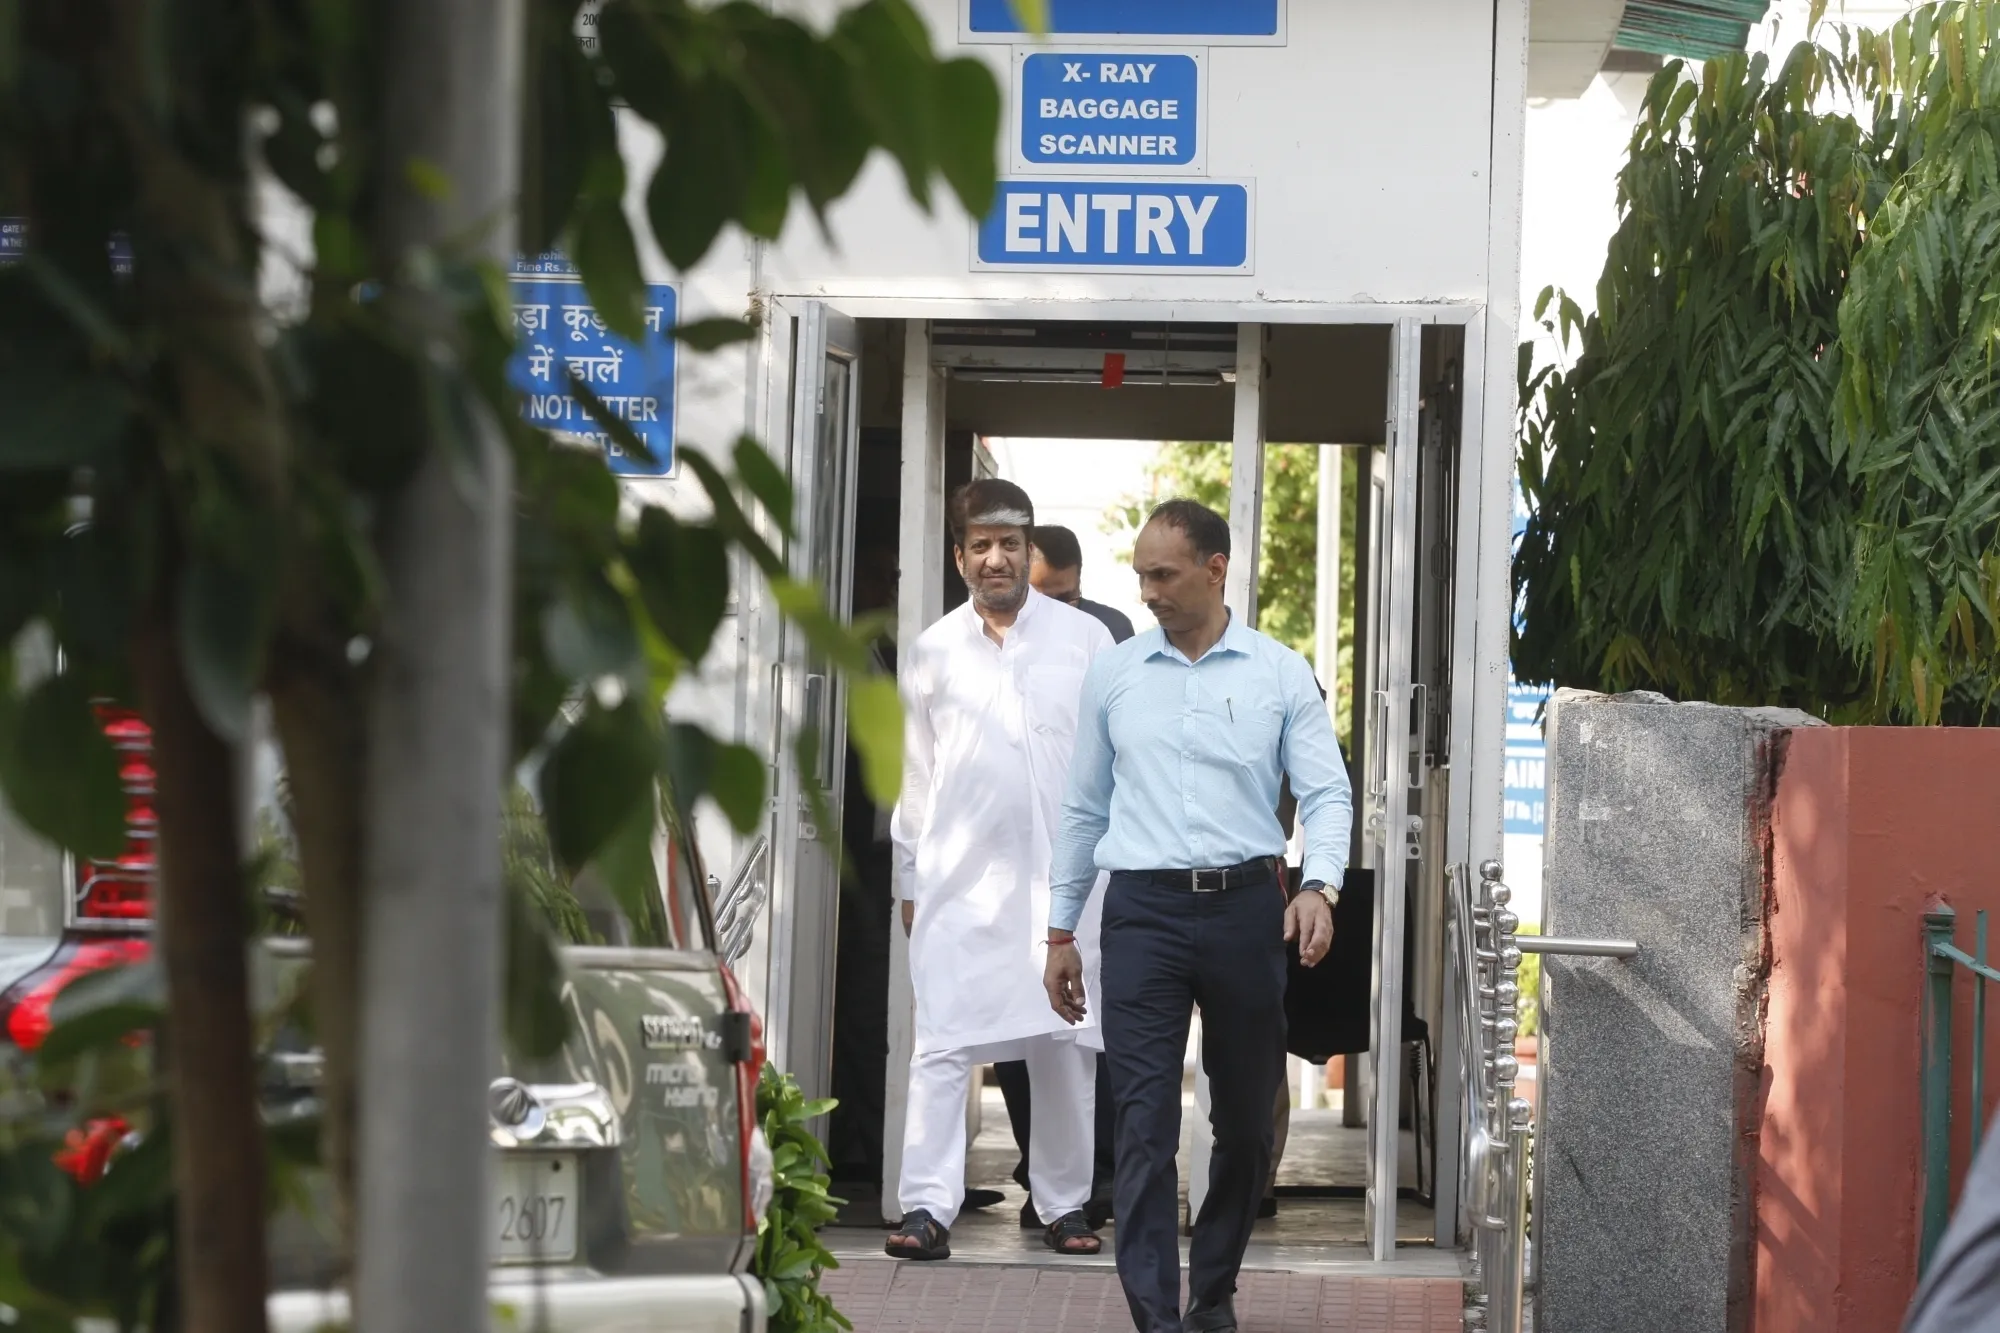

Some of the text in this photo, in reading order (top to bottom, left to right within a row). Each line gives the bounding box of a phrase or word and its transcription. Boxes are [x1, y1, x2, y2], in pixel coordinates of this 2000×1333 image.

[1100, 63, 1157, 84] RAY
[1040, 98, 1179, 120] BAGGAGE
[1039, 134, 1178, 156] SCANNER
[1005, 193, 1220, 255] ENTRY
[528, 344, 555, 382] में
[530, 394, 574, 420] NOT
[499, 1196, 566, 1241] 2607
